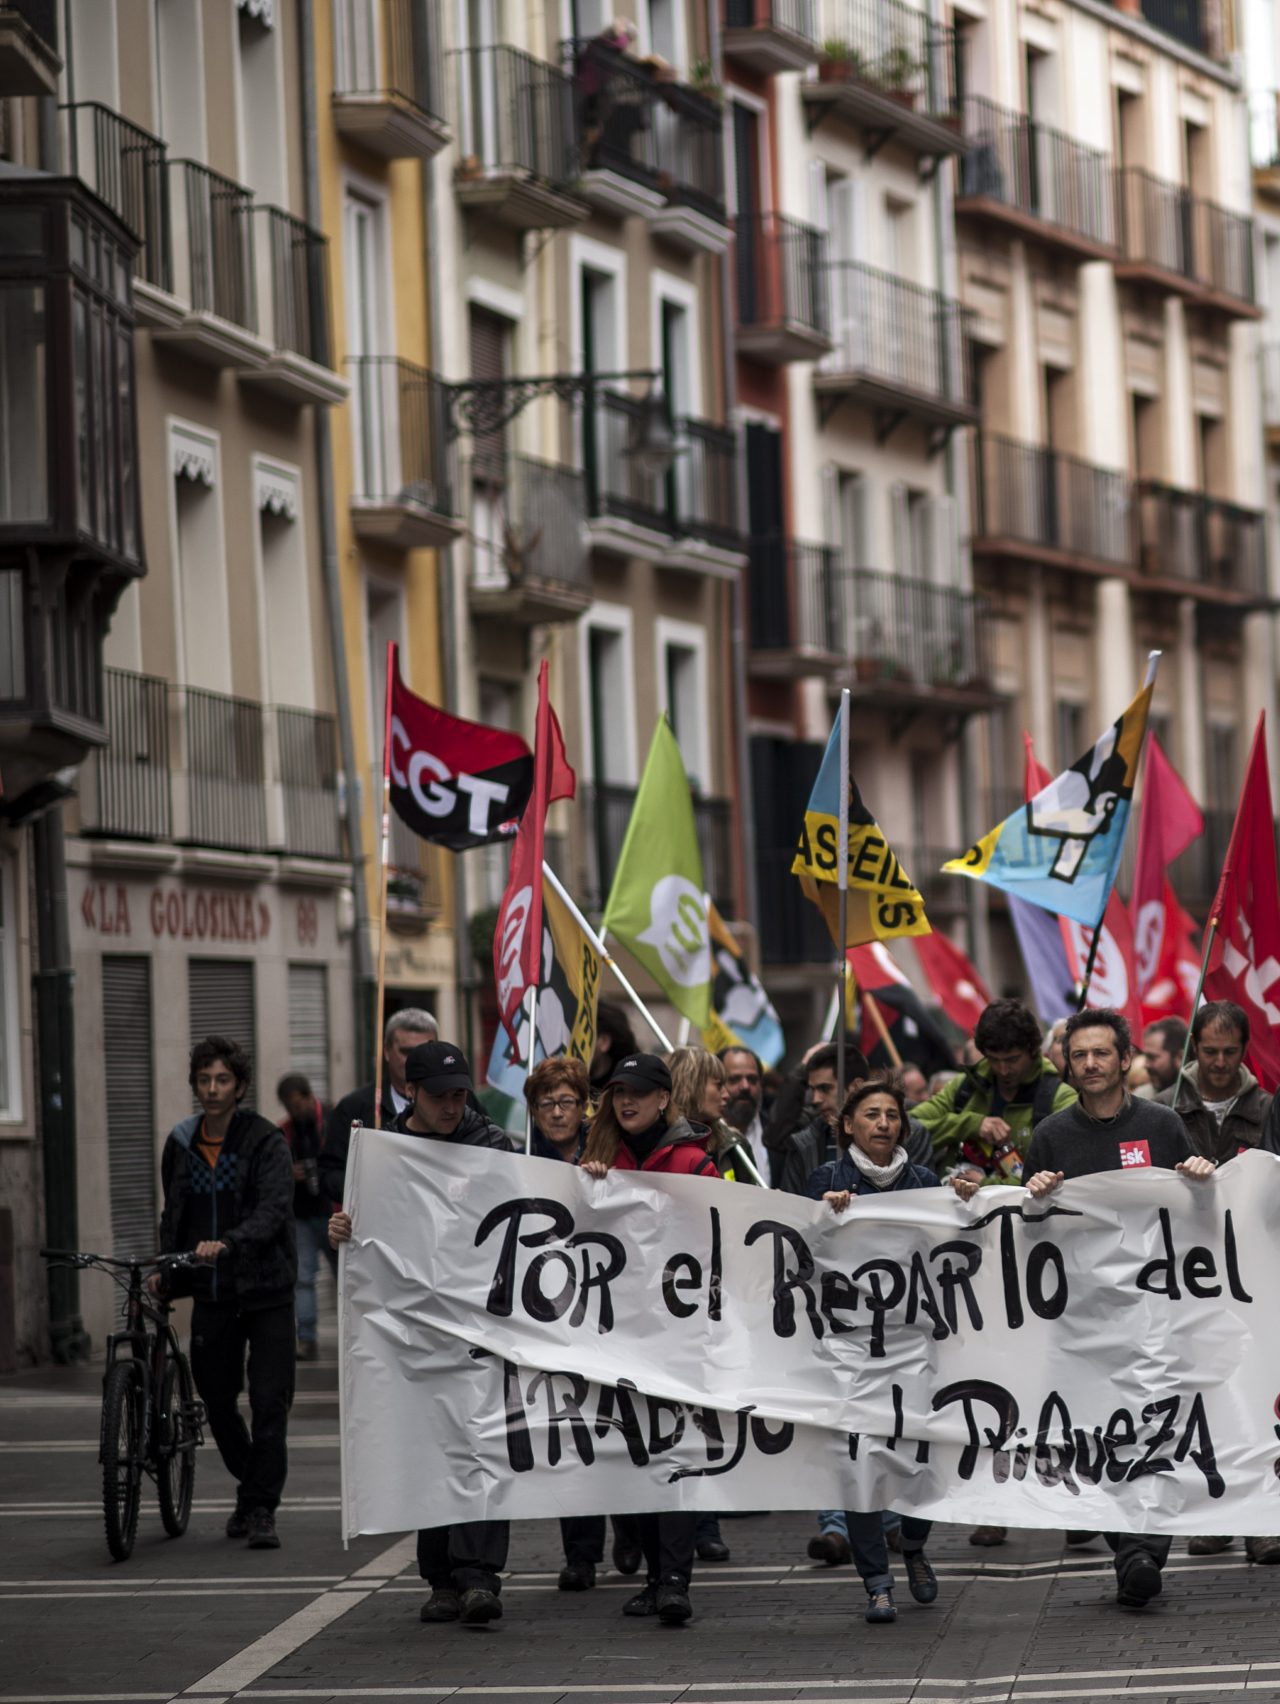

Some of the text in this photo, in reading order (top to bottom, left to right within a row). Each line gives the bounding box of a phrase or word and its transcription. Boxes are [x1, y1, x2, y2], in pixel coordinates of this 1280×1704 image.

[391, 714, 509, 835] CGT
[662, 1206, 722, 1321] el
[1136, 1208, 1252, 1302] del
